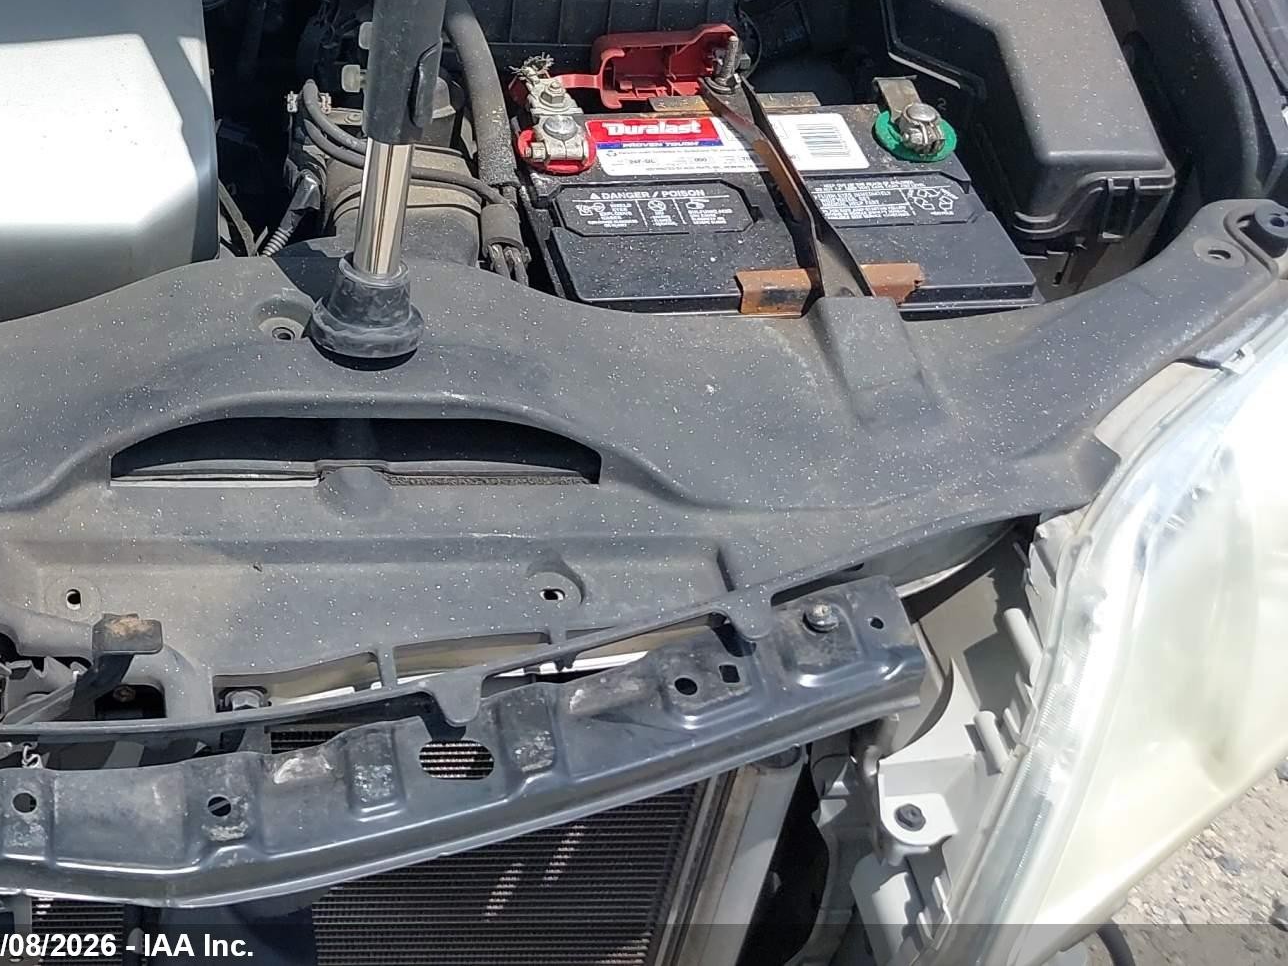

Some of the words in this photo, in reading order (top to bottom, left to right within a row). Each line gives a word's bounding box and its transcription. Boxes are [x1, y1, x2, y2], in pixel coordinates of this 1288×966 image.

[601, 120, 702, 136] Duralast
[601, 191, 651, 200] DANGER
[662, 189, 705, 198] POISON
